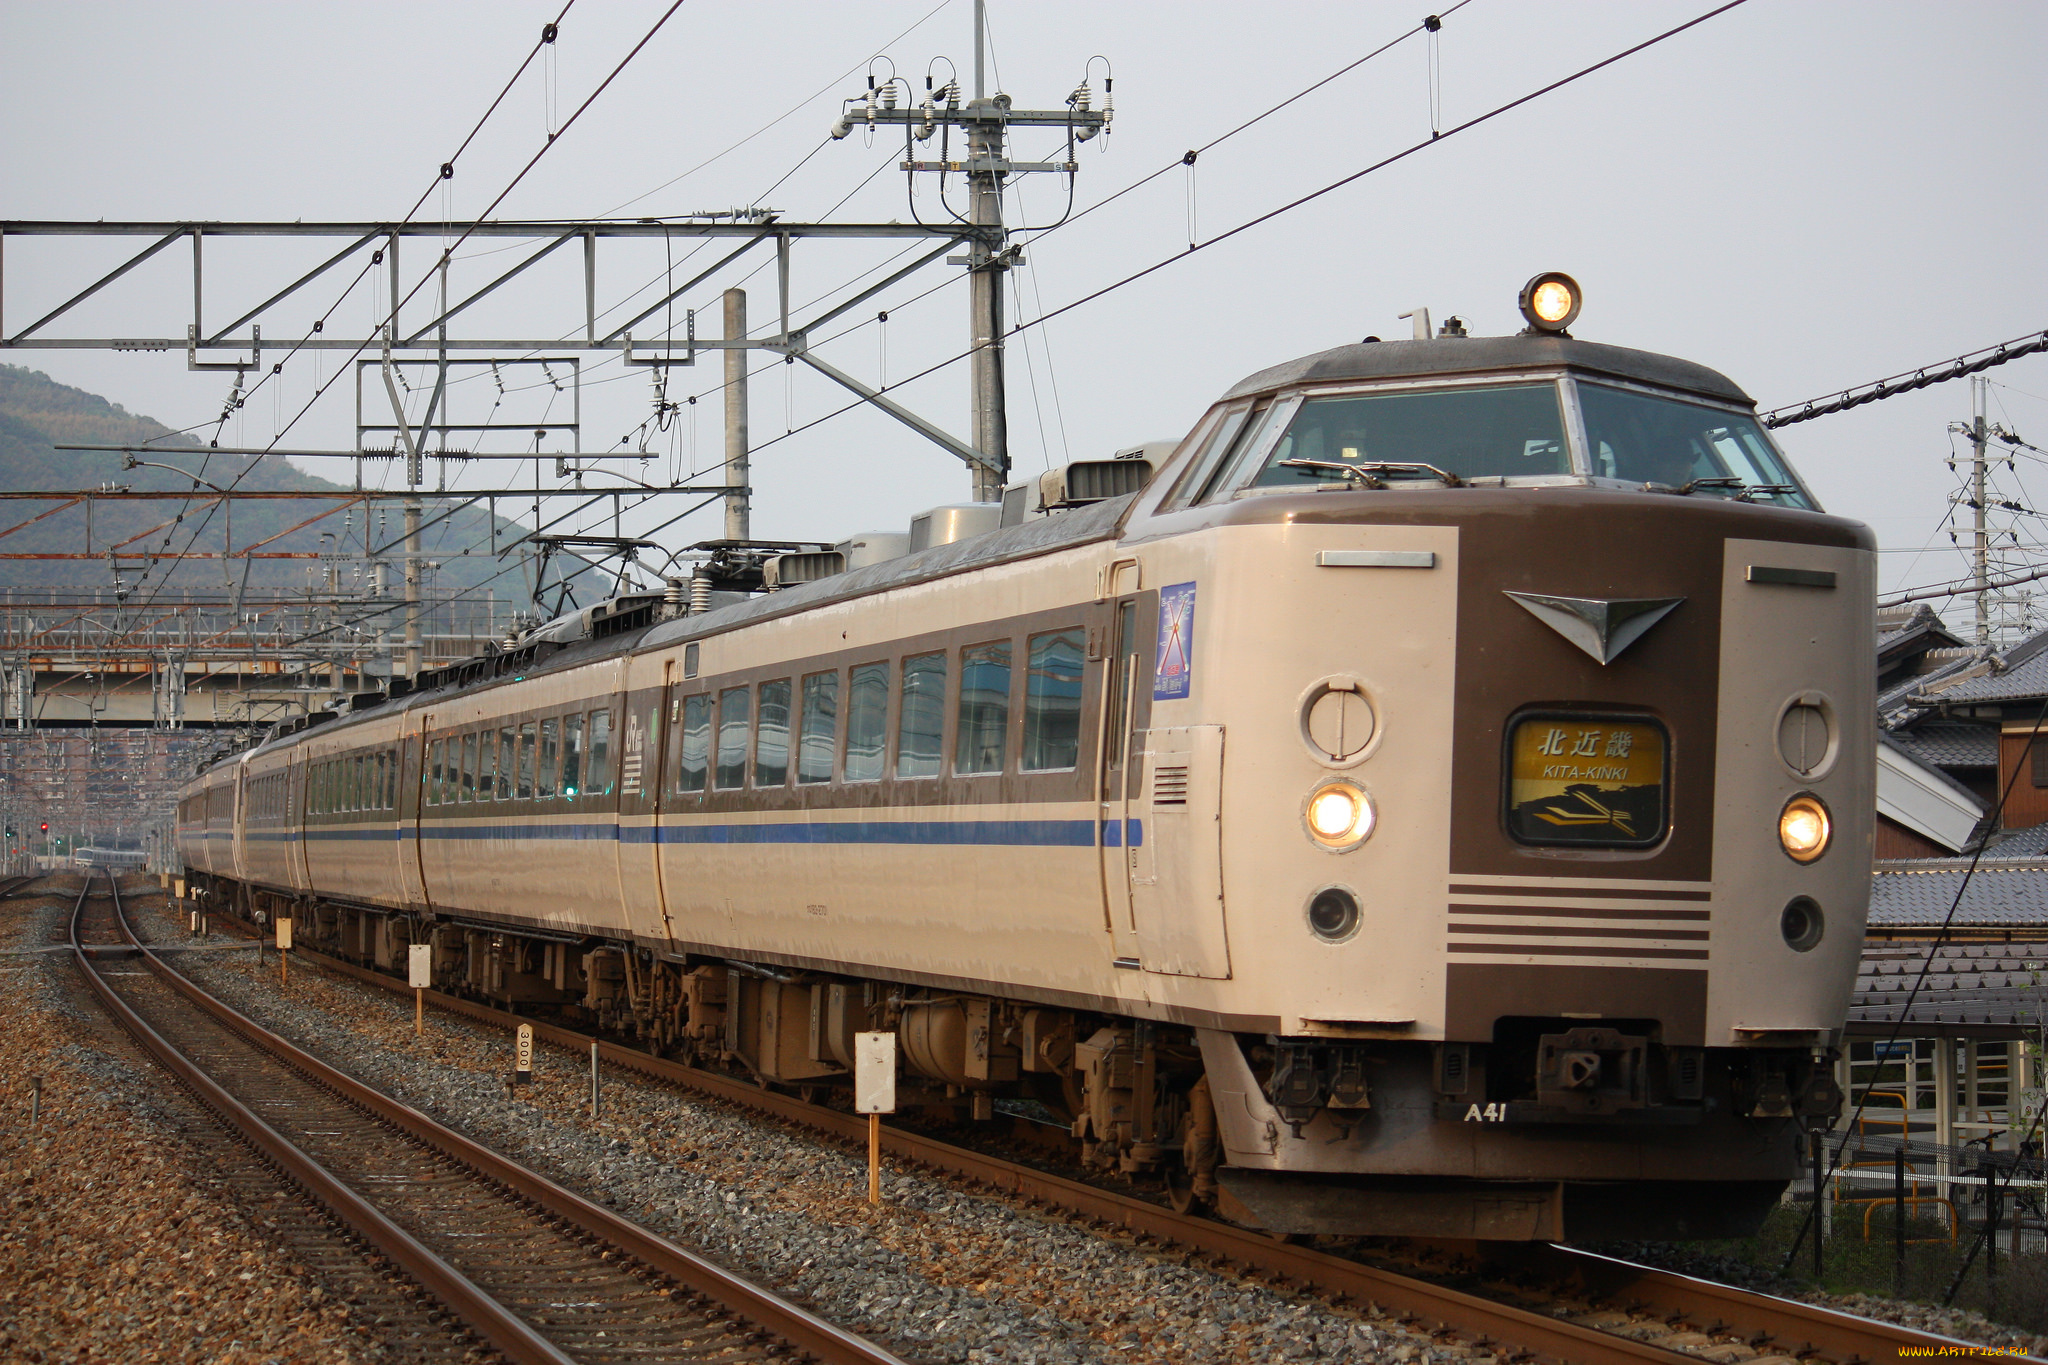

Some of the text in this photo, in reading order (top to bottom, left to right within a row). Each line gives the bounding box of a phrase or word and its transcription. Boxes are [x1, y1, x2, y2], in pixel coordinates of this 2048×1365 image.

[1537, 728, 1633, 758] 北近畿
[1543, 765, 1629, 780] KITA-KINKI
[520, 1032, 530, 1066] 3000
[1463, 1102, 1507, 1123] A41
